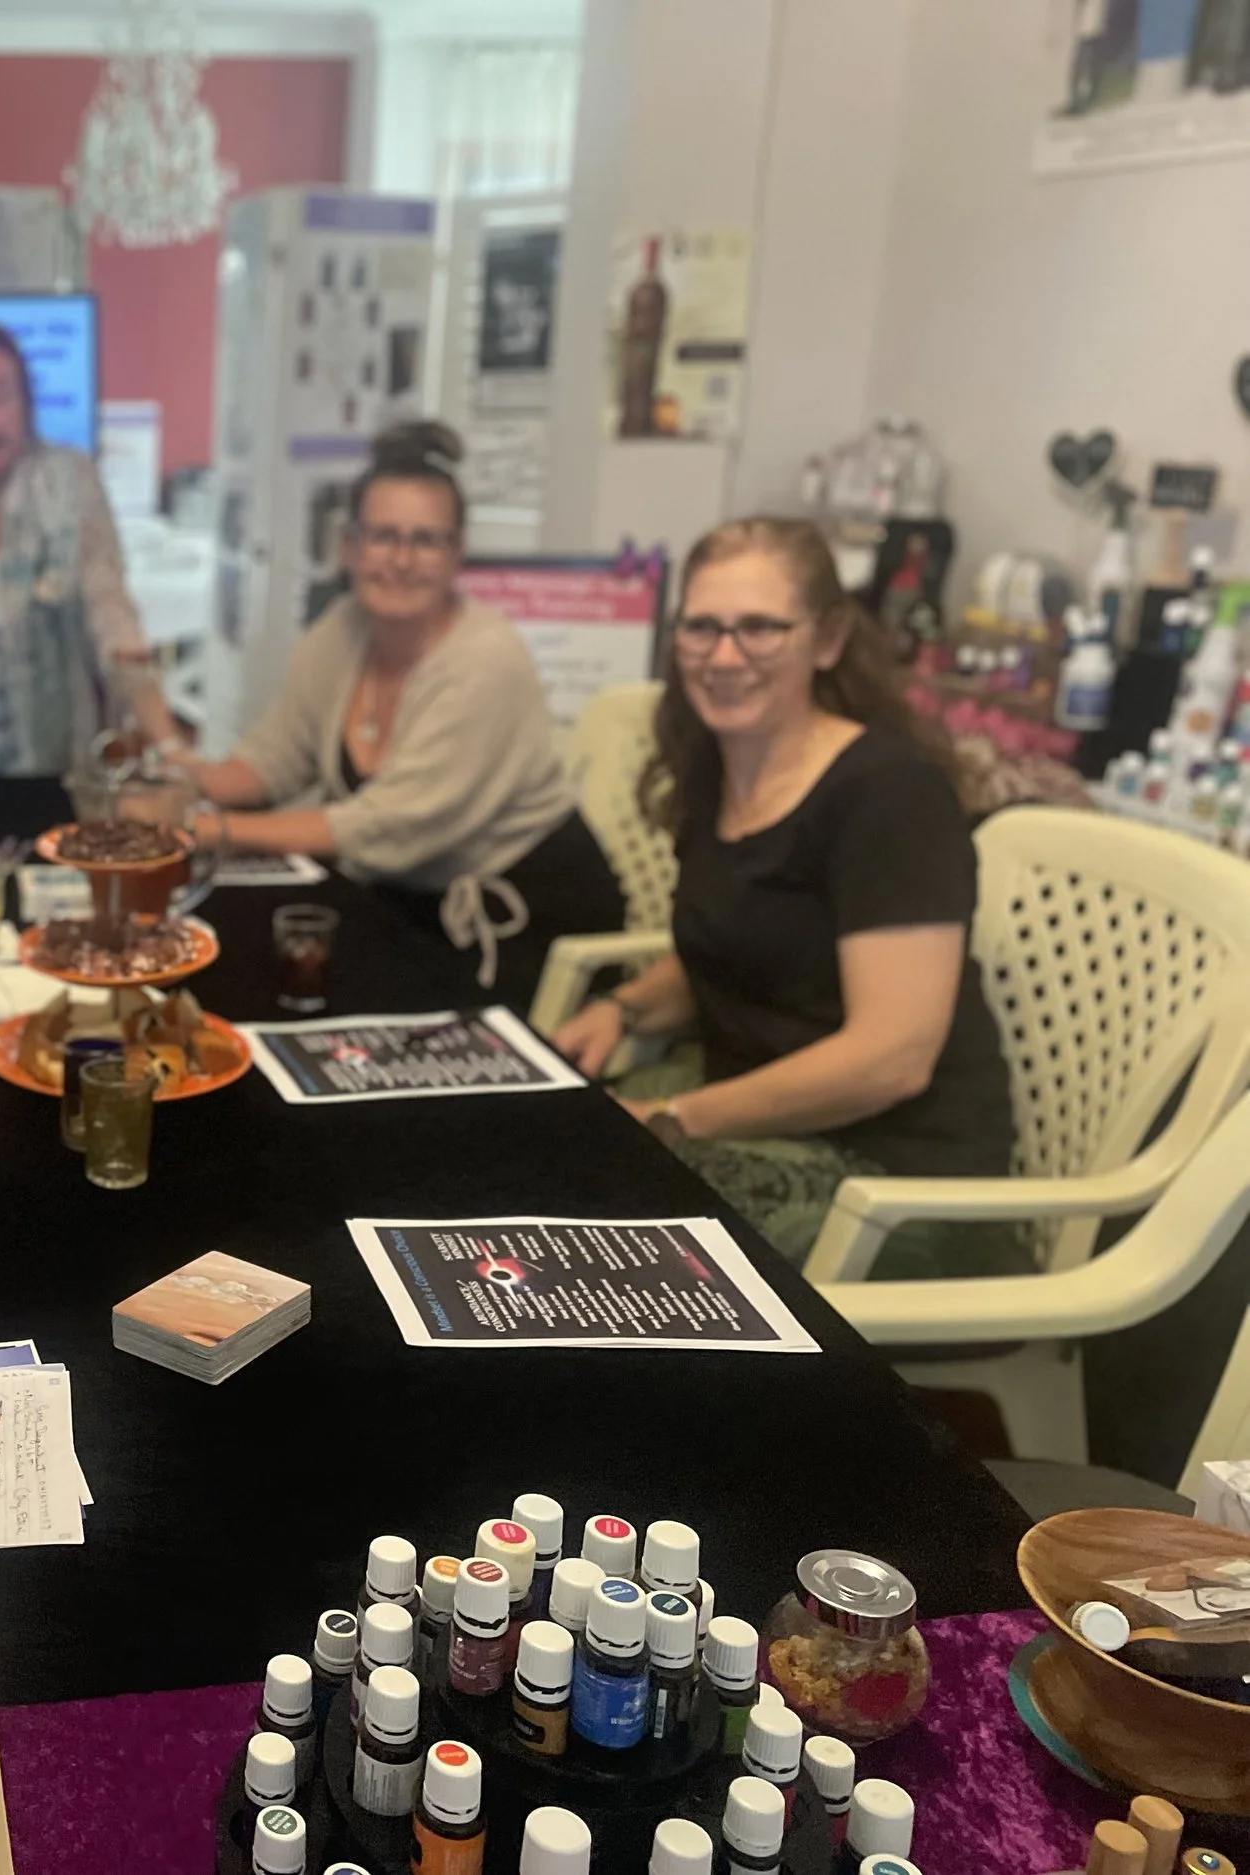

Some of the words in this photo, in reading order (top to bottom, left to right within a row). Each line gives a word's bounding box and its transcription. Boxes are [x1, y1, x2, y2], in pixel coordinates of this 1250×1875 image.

[390, 1230, 409, 1252] Choice
[430, 1232, 454, 1261] SCARCITY
[441, 1234, 466, 1260] MINDSET
[403, 1253, 429, 1287] Conscious
[428, 1300, 454, 1332] Mindset
[459, 1286, 491, 1326] ABUNDANCE
[469, 1281, 506, 1332] CONSCIOUSNESS
